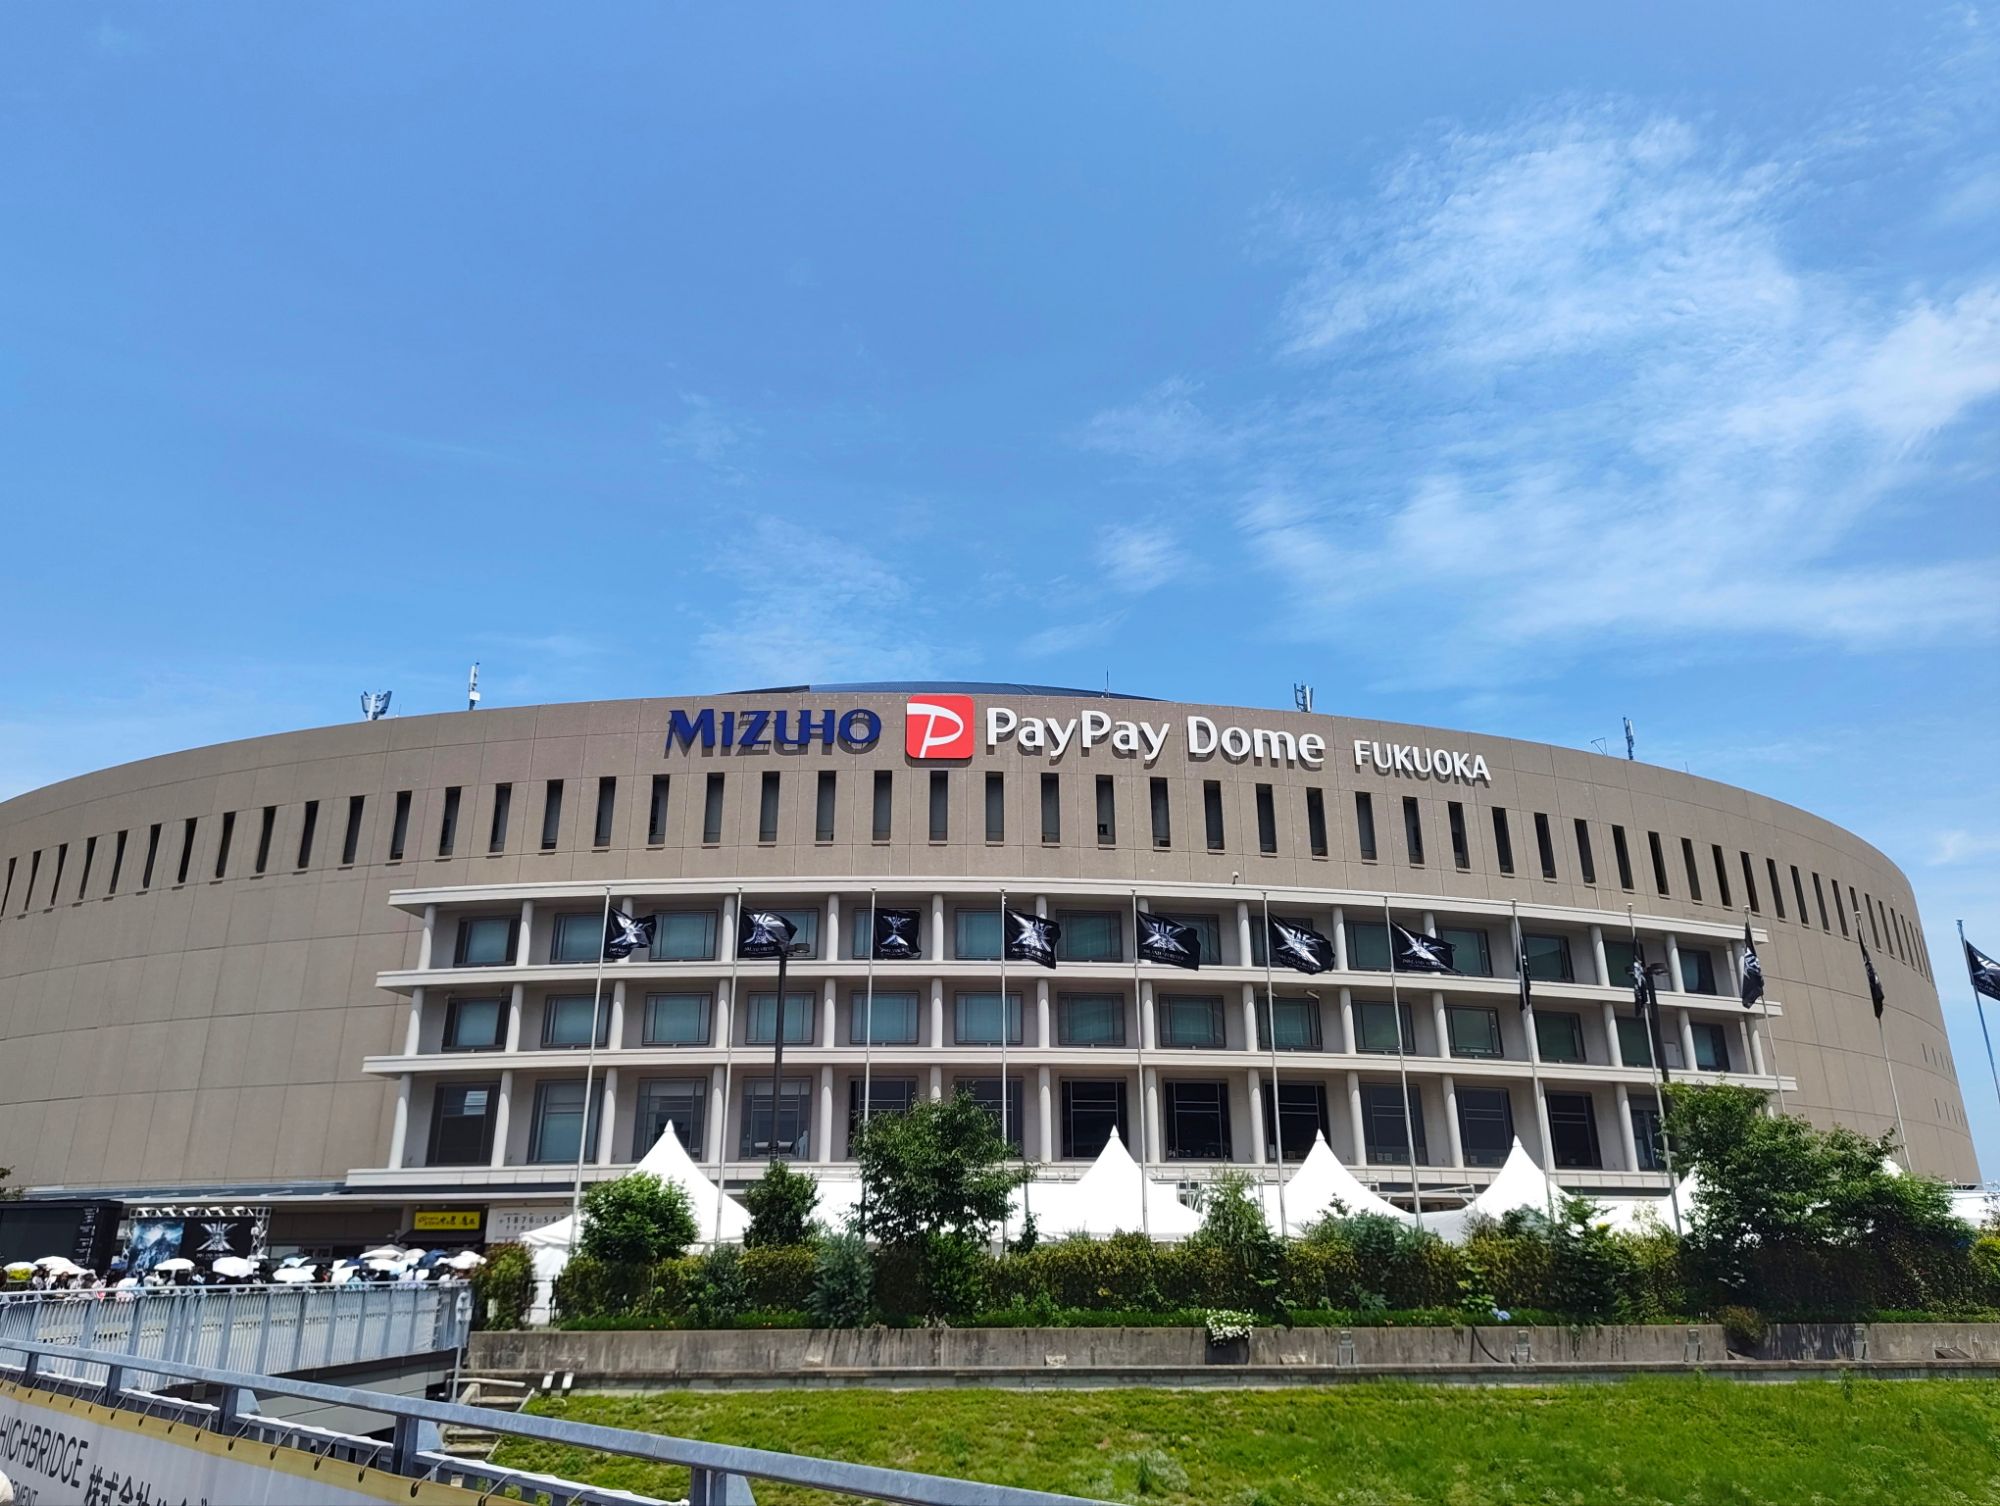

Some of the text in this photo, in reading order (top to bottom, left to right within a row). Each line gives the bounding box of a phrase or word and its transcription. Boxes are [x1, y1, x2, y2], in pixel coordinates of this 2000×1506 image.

[665, 708, 882, 749] MIZUHO
[987, 707, 1171, 760] PayPay
[1187, 715, 1326, 763] Dome
[1353, 739, 1492, 781] FUKUOKA
